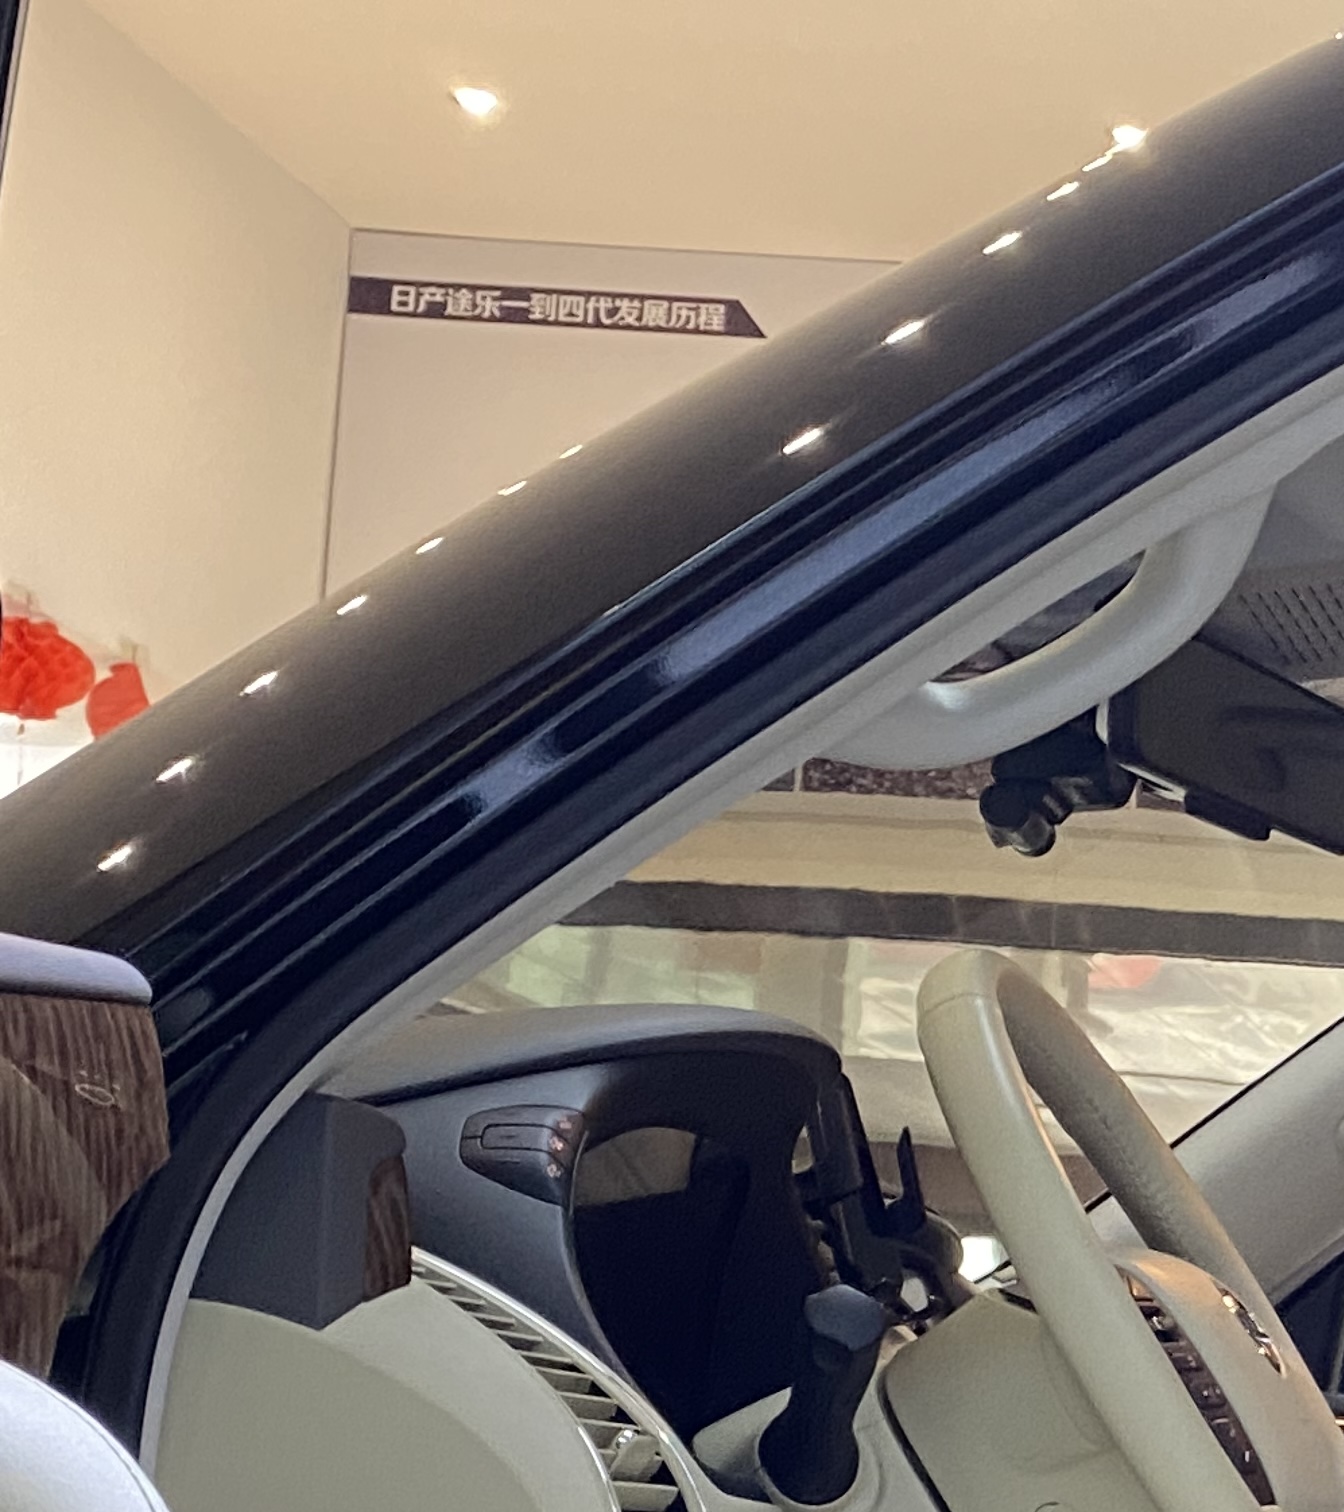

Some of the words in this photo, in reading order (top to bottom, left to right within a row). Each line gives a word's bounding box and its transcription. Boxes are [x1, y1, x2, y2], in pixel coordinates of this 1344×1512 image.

[389, 283, 727, 333] 日产途乐一到四代发展历程
